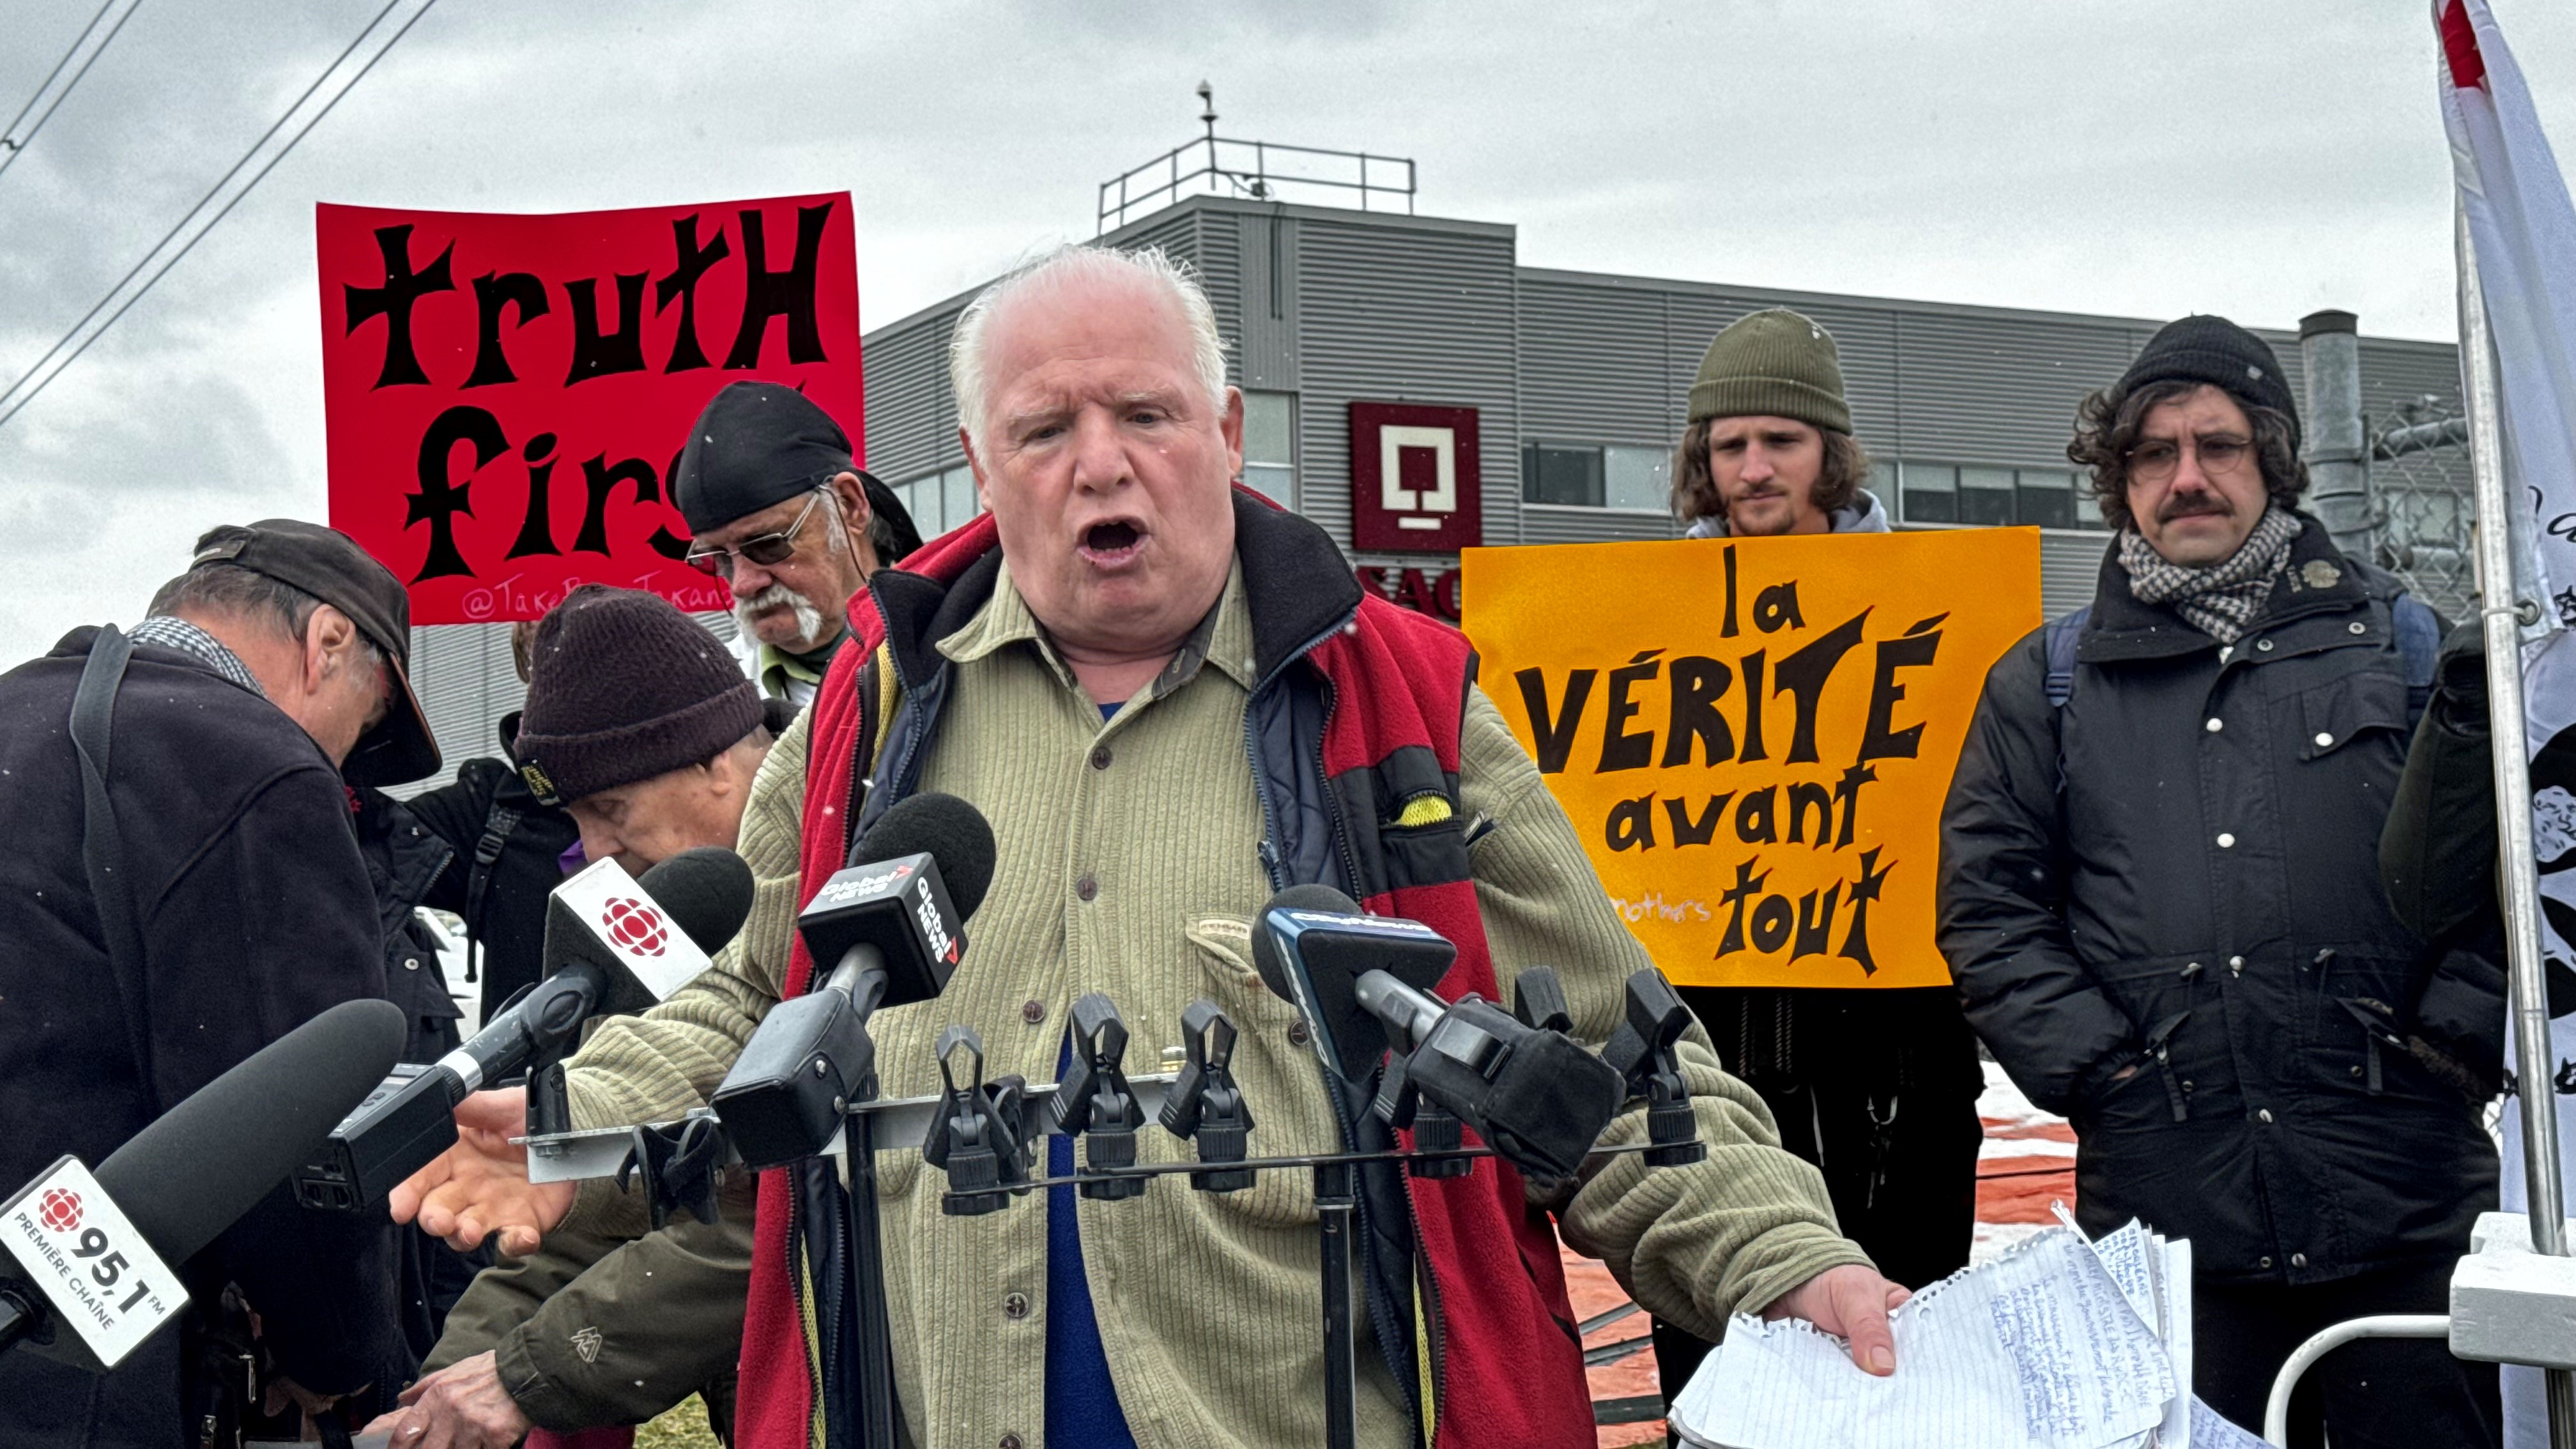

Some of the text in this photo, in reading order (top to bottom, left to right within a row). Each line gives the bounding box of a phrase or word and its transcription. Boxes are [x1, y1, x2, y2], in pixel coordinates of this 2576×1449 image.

[1720, 544, 1805, 638] la
[1514, 605, 1951, 774] VÉRITÉ
[1605, 761, 1879, 853] avant
[820, 871, 898, 896] Global
[829, 882, 888, 903] NEWS
[917, 877, 952, 954] Global
[1713, 845, 1899, 979] tout
[917, 903, 944, 963] NEWS
[14, 1212, 115, 1331] PREMIÈRE CHAÎNE
[70, 1227, 165, 1315] 95,1 FM
